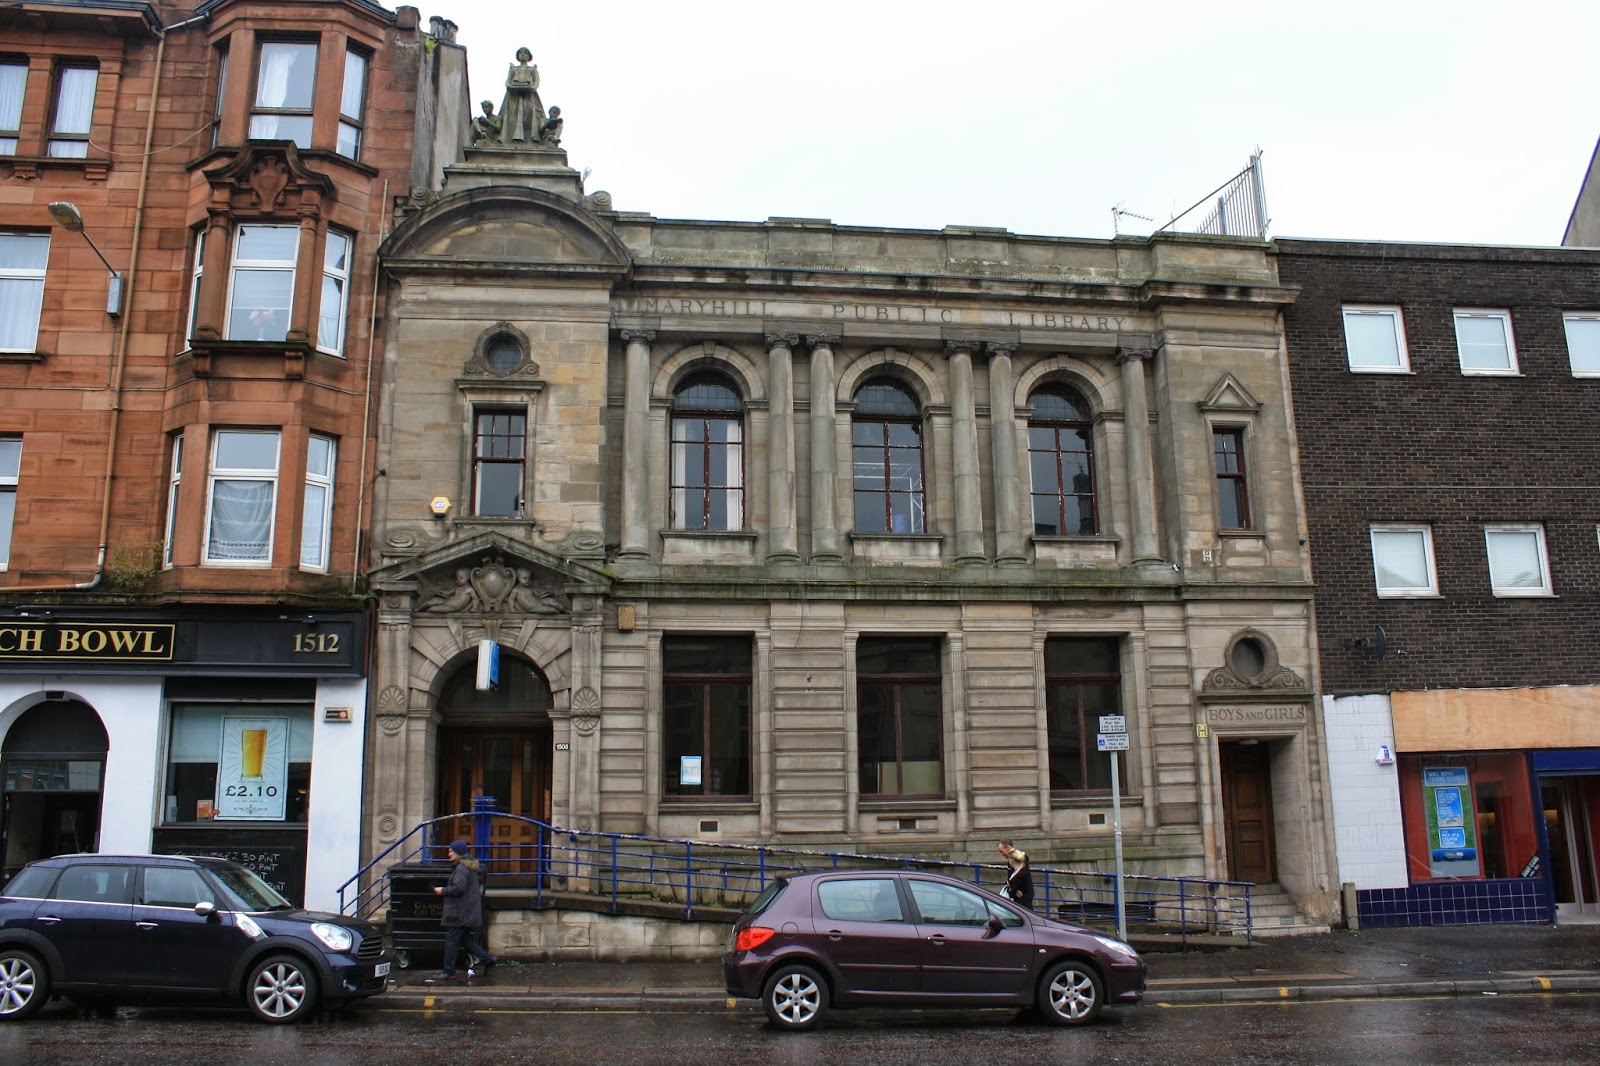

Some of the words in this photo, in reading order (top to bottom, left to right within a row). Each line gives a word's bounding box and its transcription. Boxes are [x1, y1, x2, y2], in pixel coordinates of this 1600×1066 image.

[646, 299, 774, 316] MARYHILL
[832, 305, 952, 323] PUBLIC
[1008, 313, 1126, 331] LIBRARY
[57, 629, 164, 653] BOWL
[293, 633, 340, 653] 1512
[1209, 708, 1244, 721] BOYS
[1245, 711, 1264, 721] AND
[1264, 707, 1305, 720] GIRLS
[225, 786, 278, 797] £2.10
